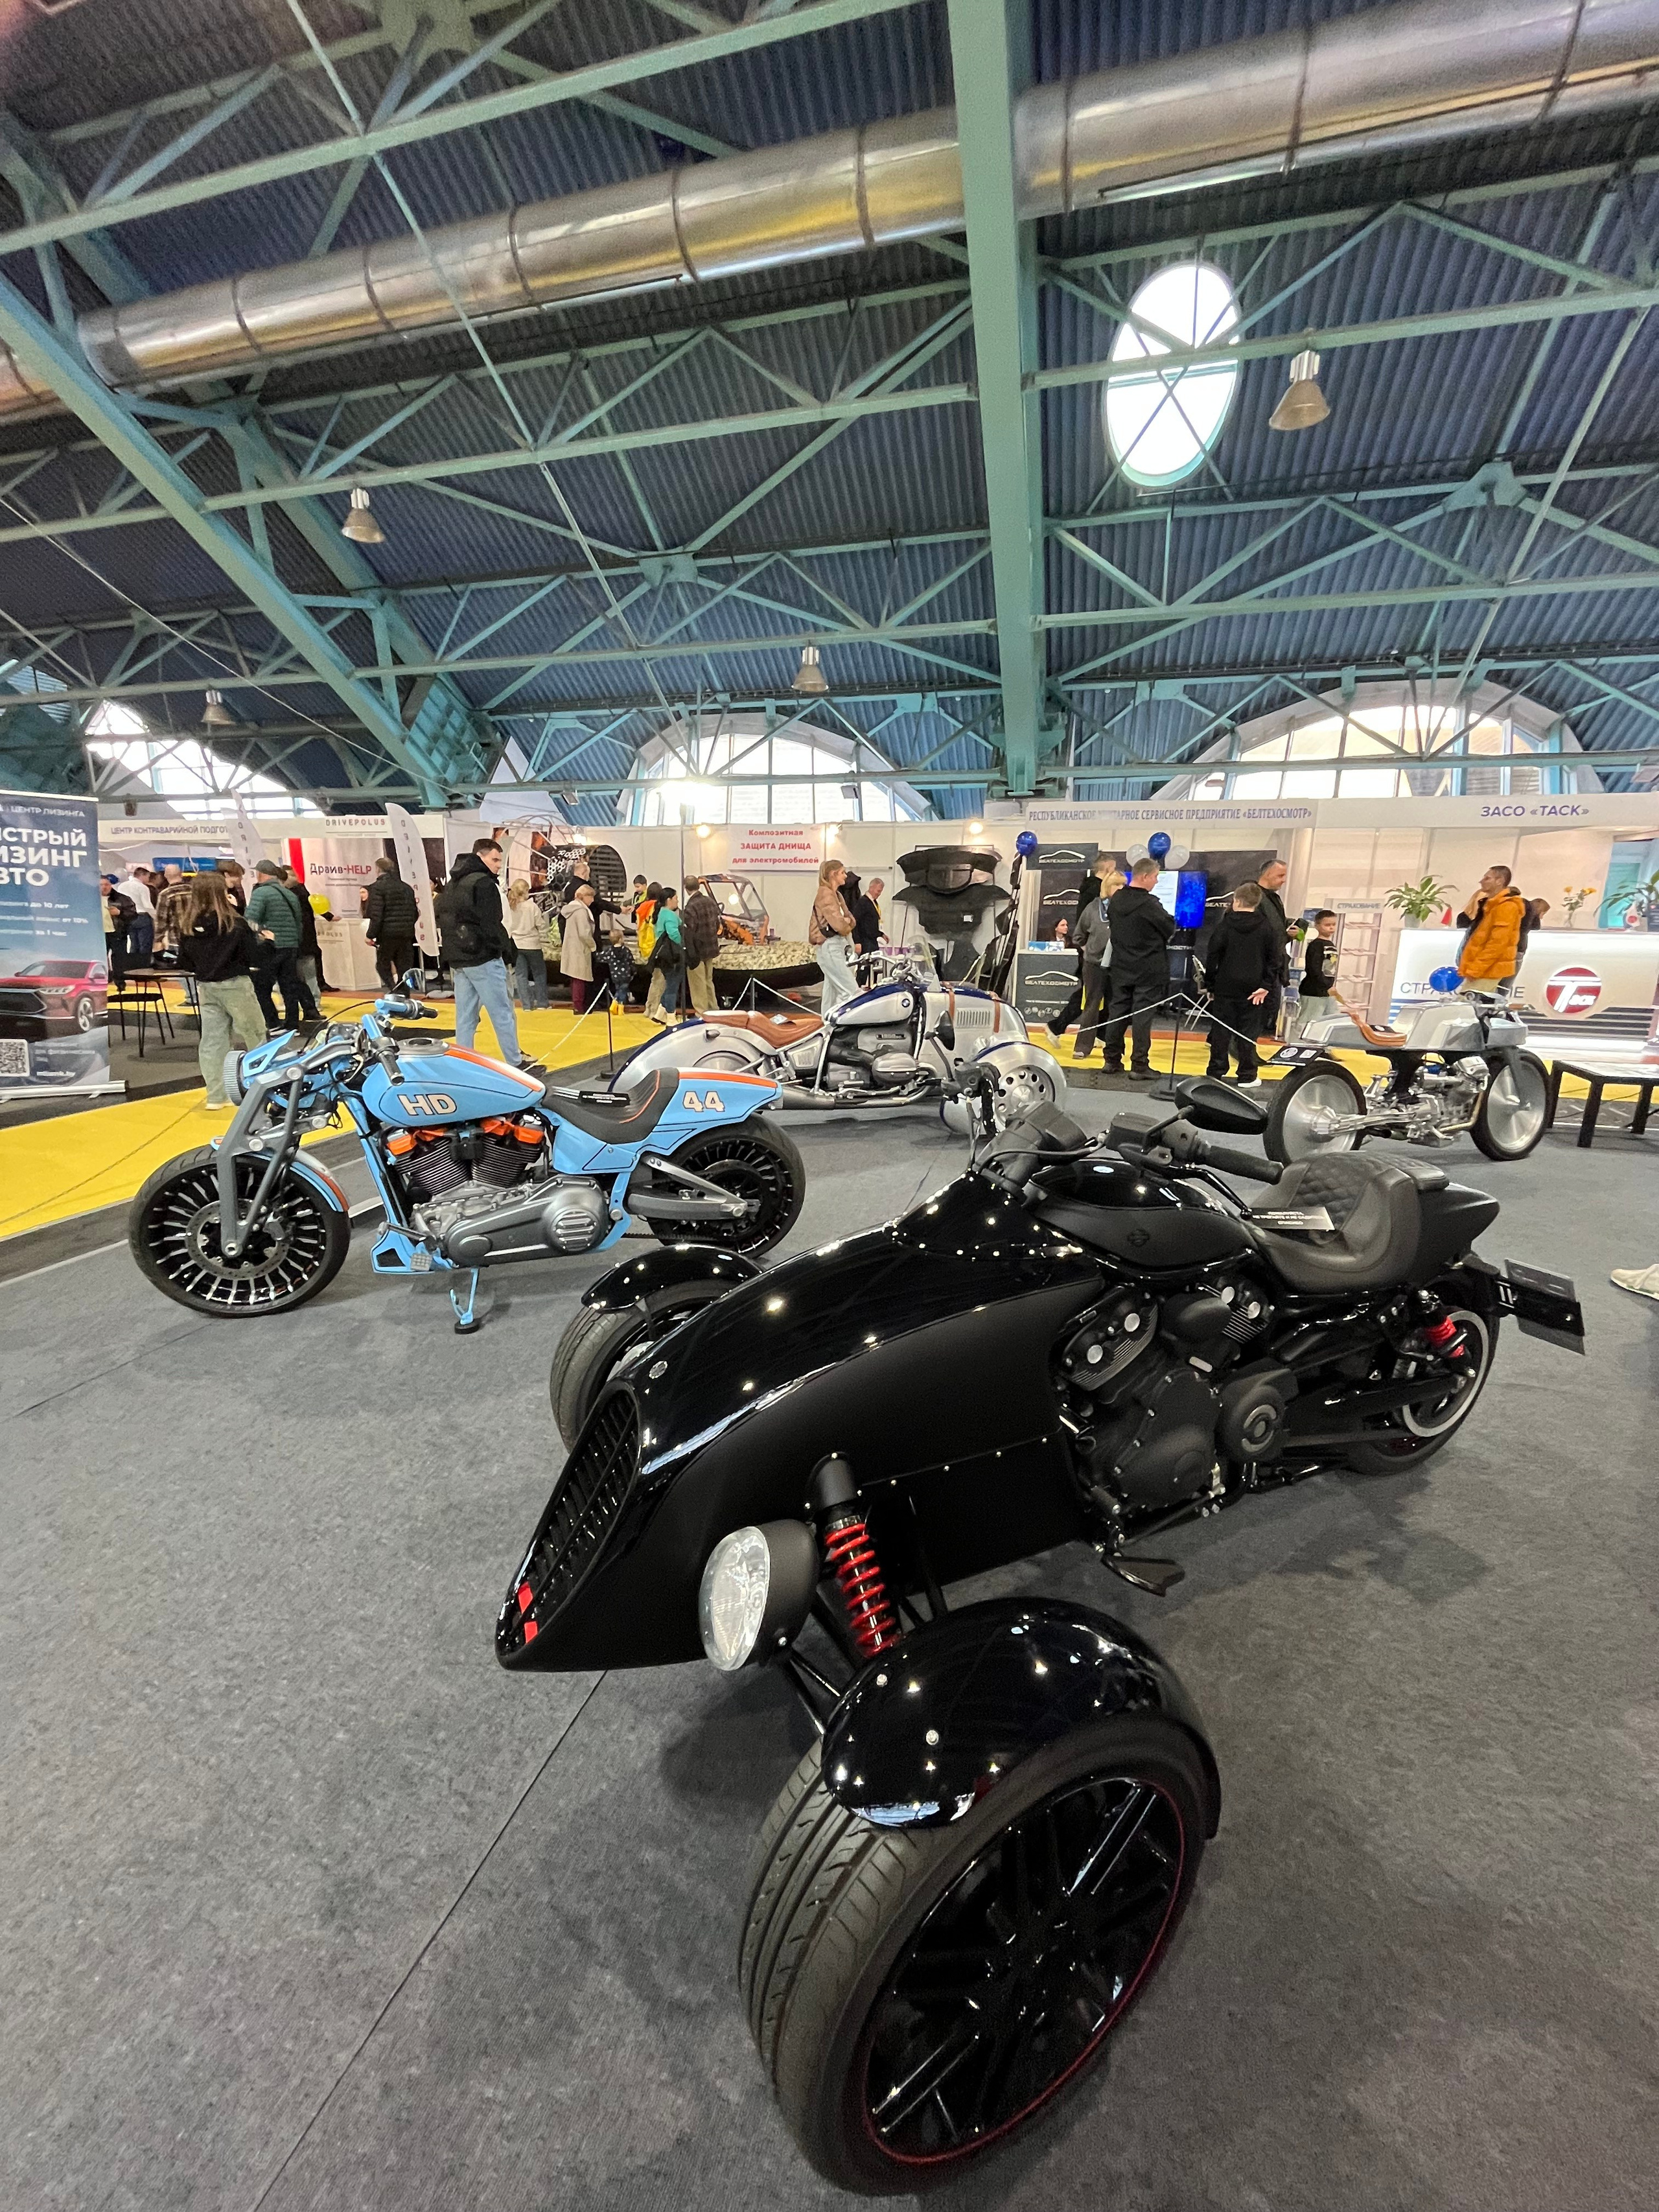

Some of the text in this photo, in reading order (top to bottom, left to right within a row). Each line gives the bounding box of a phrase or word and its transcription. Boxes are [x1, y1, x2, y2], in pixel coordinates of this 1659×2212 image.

[43, 808, 85, 817] ЛИЗИНГА
[1029, 810, 1095, 821] РЕСПУБЛИКАНСКОЕ
[1141, 809, 1183, 820] СЕРВИСНОЕ
[1185, 809, 1240, 821] ПРЕДПРИЯТИЕ
[1481, 805, 1590, 817] ЗАСО «ТАСК»
[111, 826, 133, 835] ЦЕНТР
[134, 825, 198, 835] КОНТРАВАРИЙНОЙ
[0, 827, 87, 847] СТРЫЙ
[740, 843, 811, 851] ЗАЩИТА ДНИЩА
[749, 856, 819, 865] электромобилей
[399, 1093, 457, 1116] HD
[682, 1091, 725, 1113] 44
